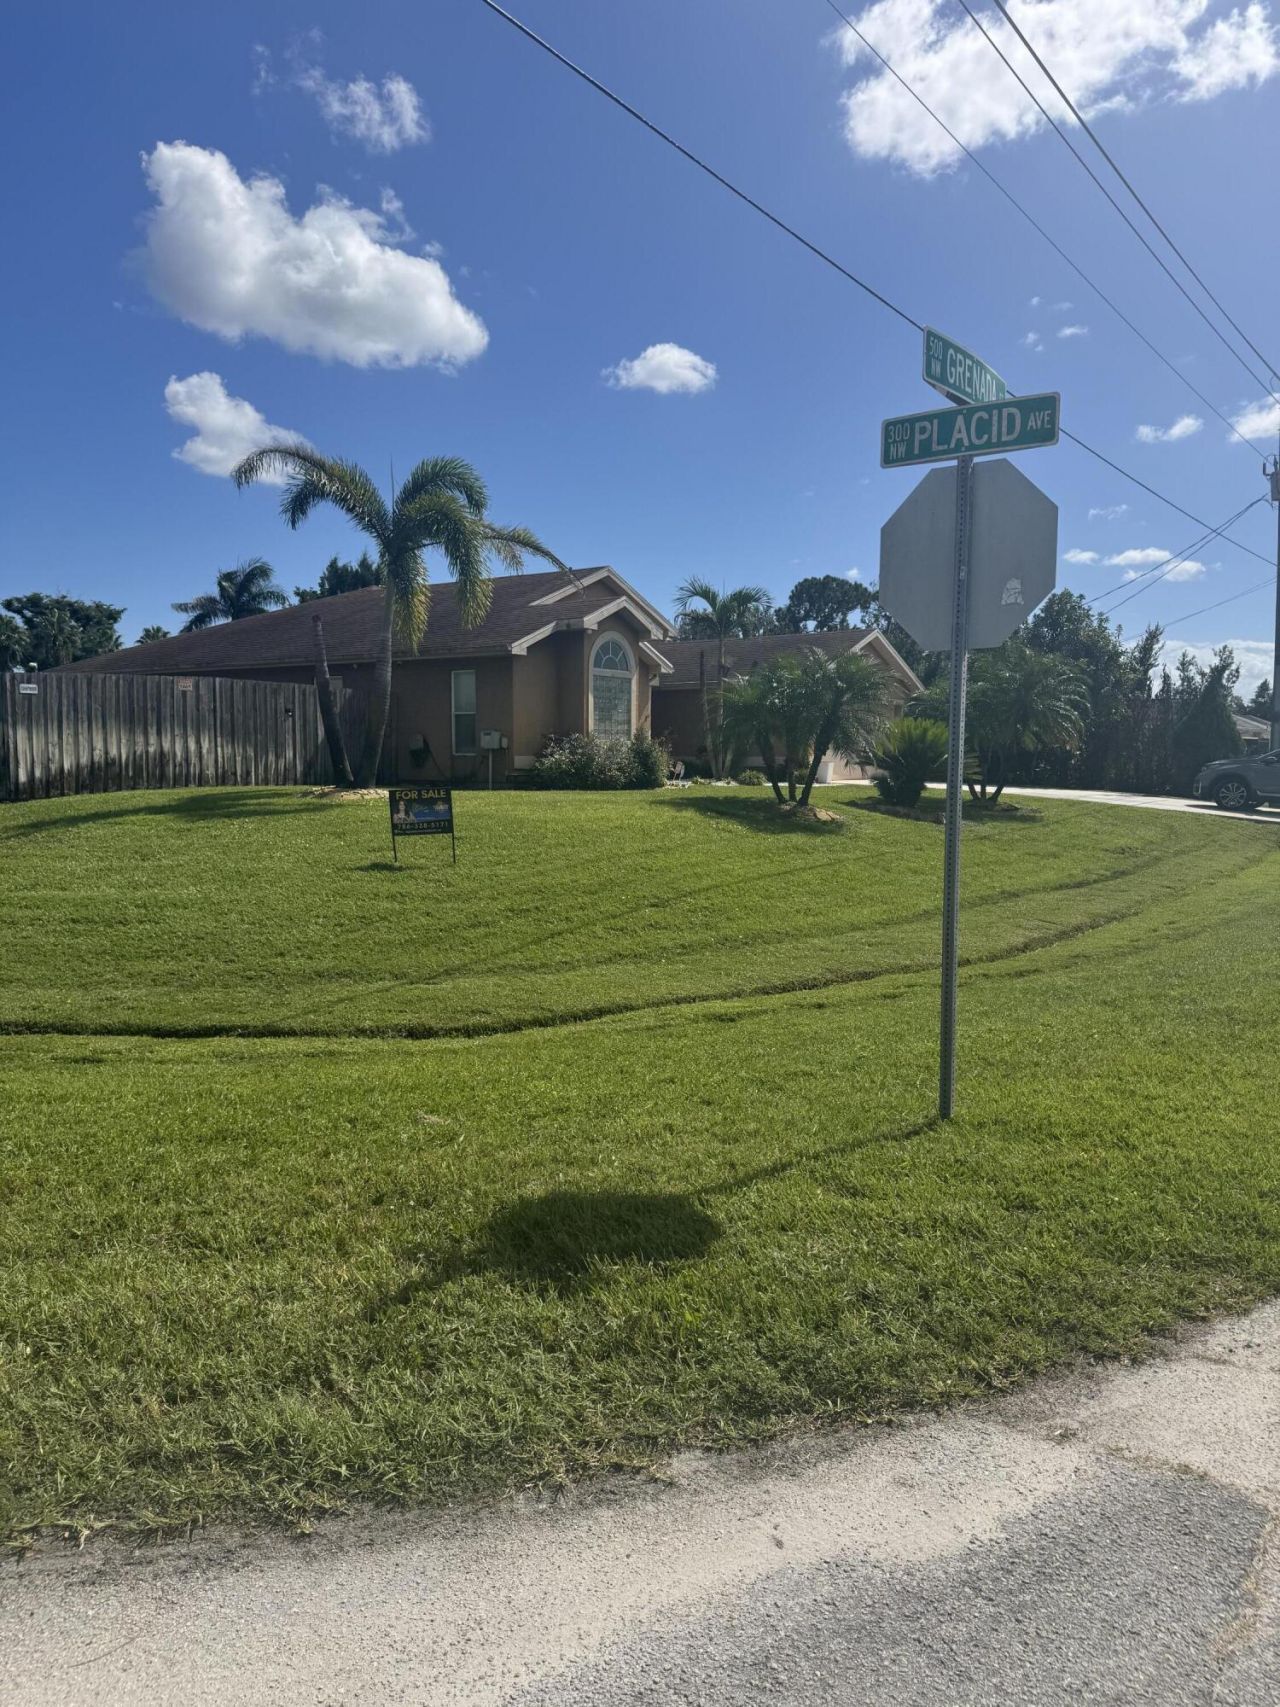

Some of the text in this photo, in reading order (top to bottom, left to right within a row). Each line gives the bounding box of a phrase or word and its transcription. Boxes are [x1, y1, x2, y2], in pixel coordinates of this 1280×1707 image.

[929, 337, 943, 359] 500
[931, 361, 941, 378] NW
[946, 349, 997, 402] GRENADA
[888, 423, 910, 443] 300
[913, 407, 1052, 454] PLACID AVE
[889, 443, 907, 460] NW
[395, 789, 447, 800] FOR SALE
